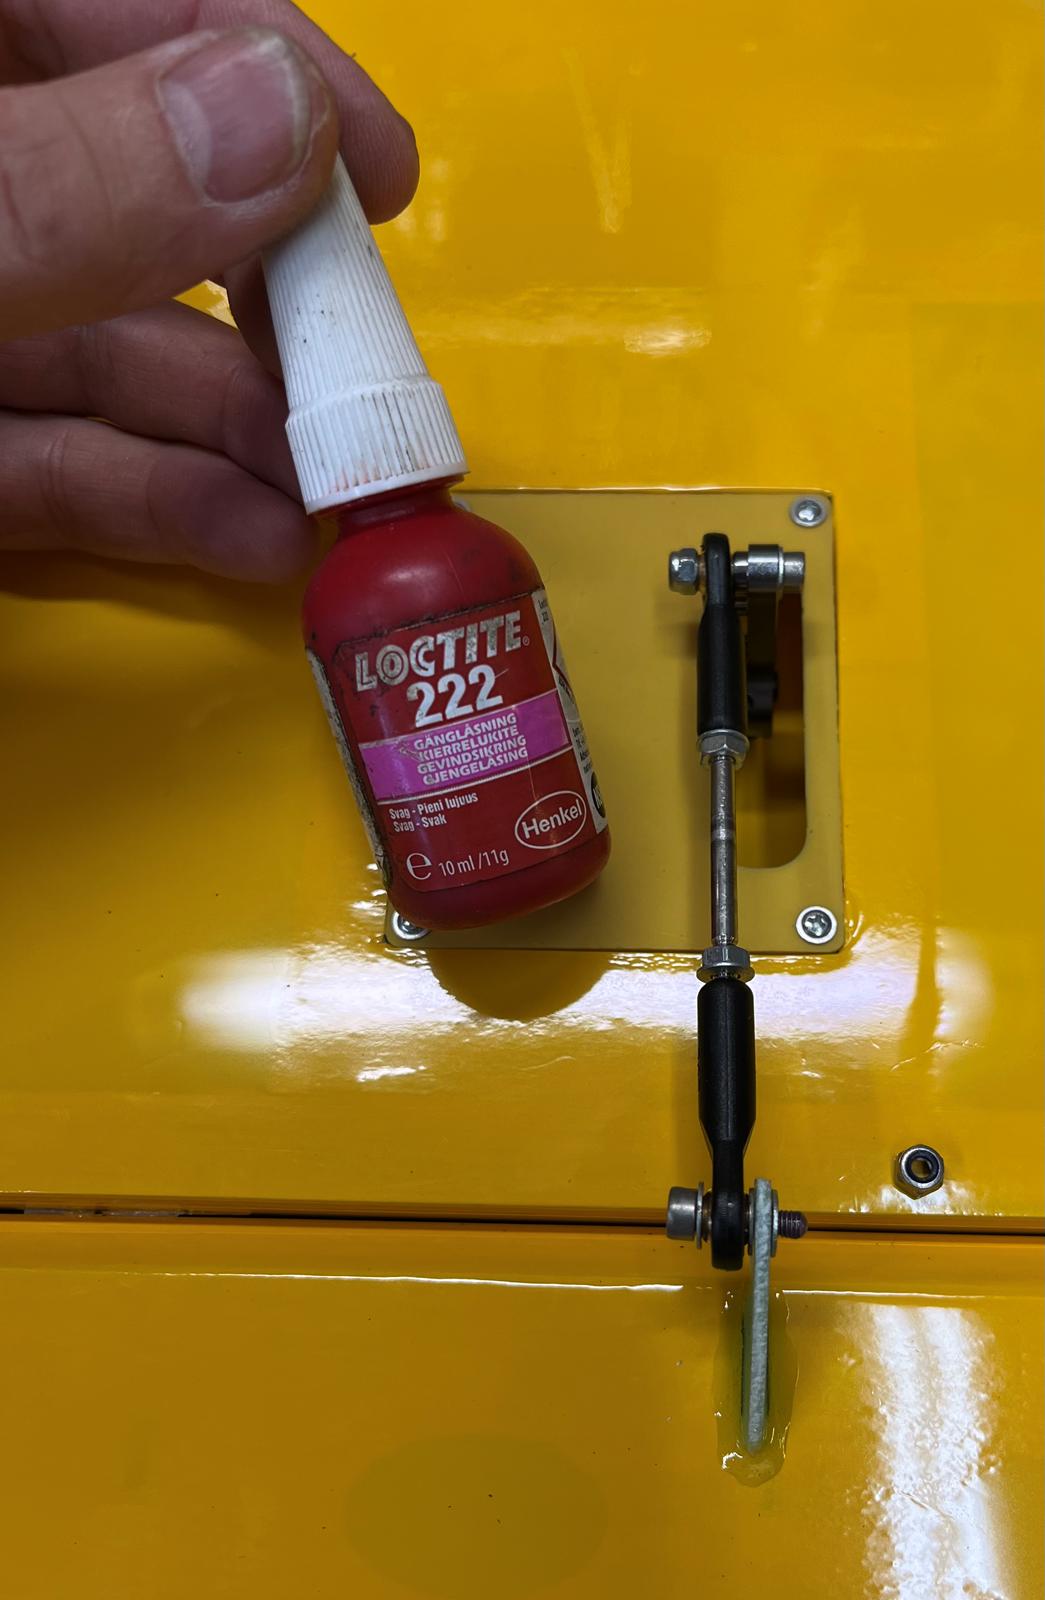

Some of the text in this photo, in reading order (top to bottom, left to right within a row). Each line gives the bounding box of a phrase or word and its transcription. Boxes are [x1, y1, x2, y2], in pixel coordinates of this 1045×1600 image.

[355, 610, 521, 692] LOCTITE
[407, 664, 503, 728] 222
[414, 713, 517, 750] GÄNGLÅSNING
[419, 725, 519, 761] KIERRELUKITE
[417, 735, 526, 774] GEVINDSIKRING
[389, 807, 411, 821] Svag
[418, 799, 444, 815] Pieni
[445, 792, 479, 809] lujuus
[393, 820, 415, 833] Svag
[421, 813, 447, 828] Svak
[522, 799, 582, 839] Henkel
[439, 860, 455, 877] 10
[458, 857, 475, 873] ml
